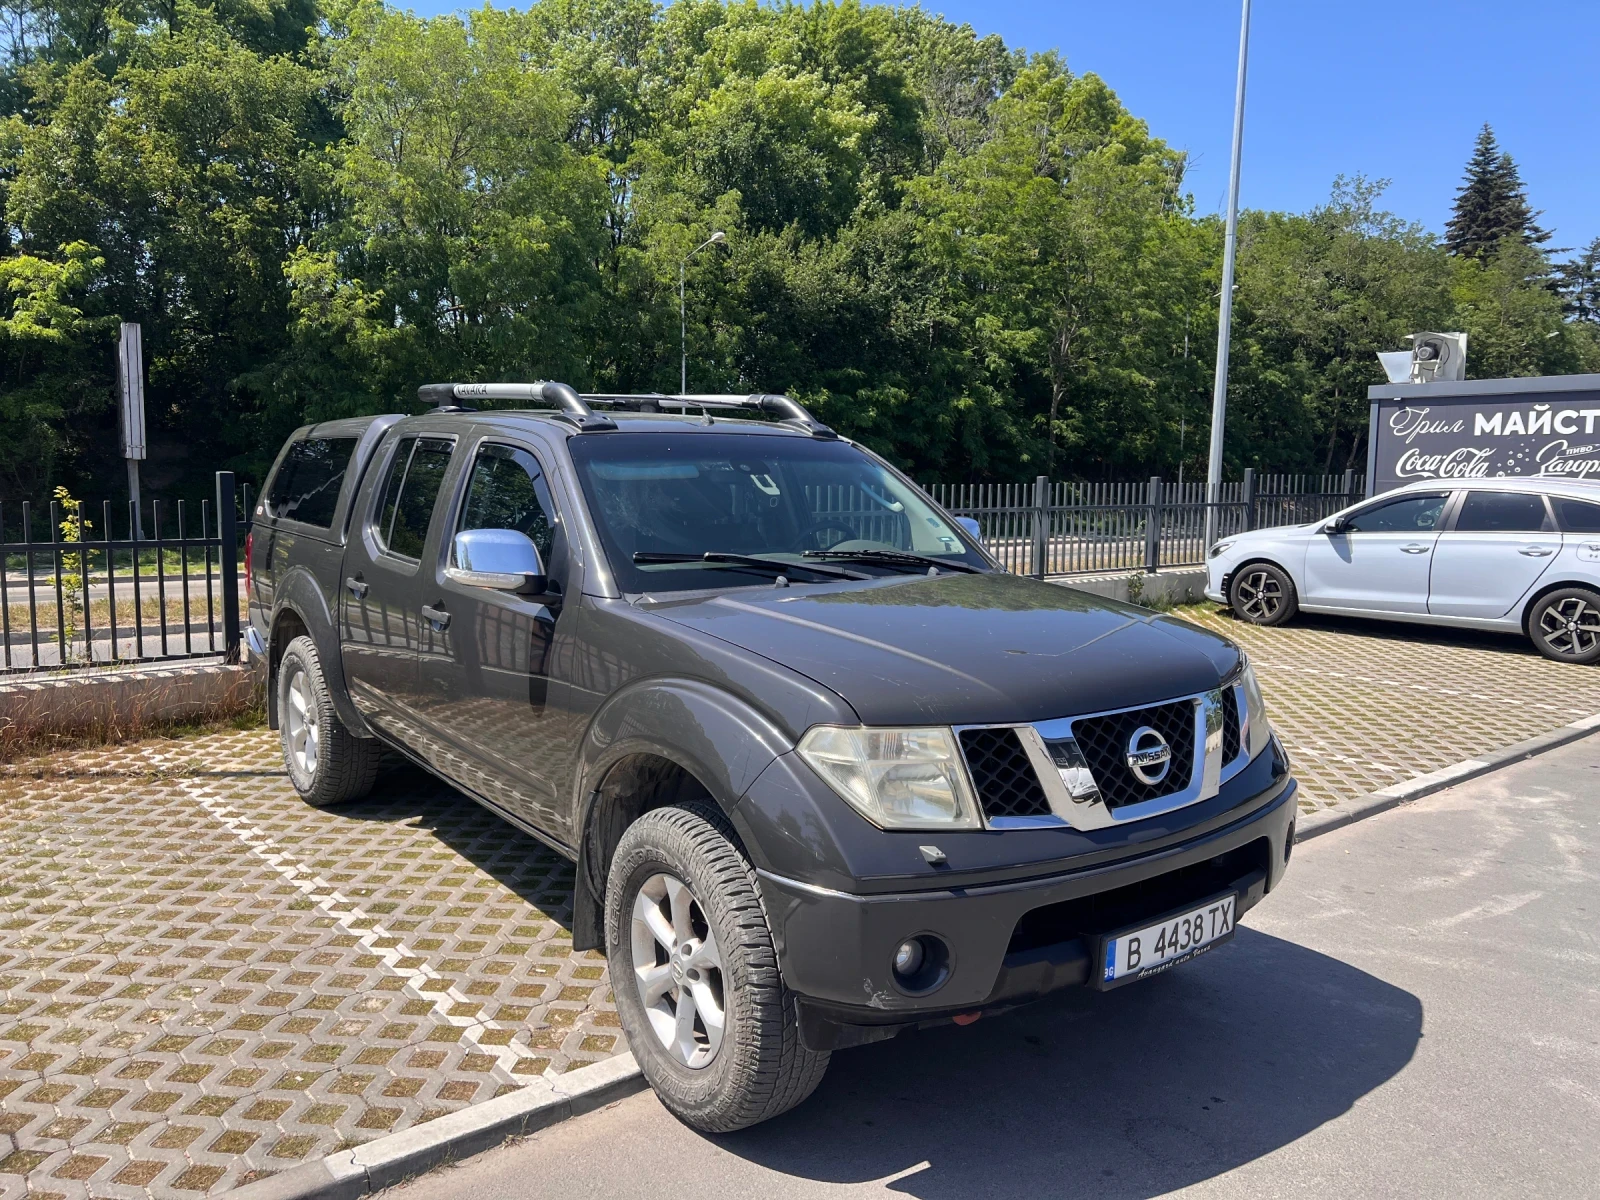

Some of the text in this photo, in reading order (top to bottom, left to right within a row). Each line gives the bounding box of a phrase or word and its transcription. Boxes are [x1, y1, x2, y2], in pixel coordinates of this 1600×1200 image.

[1390, 404, 1600, 444] Грил МАЙСТ
[1395, 447, 1497, 478] Coca-Cola
[1530, 439, 1600, 479] Загор
[1136, 745, 1170, 764] NISSAN
[1154, 915, 1203, 958] 4438
[1208, 901, 1232, 938] TX
